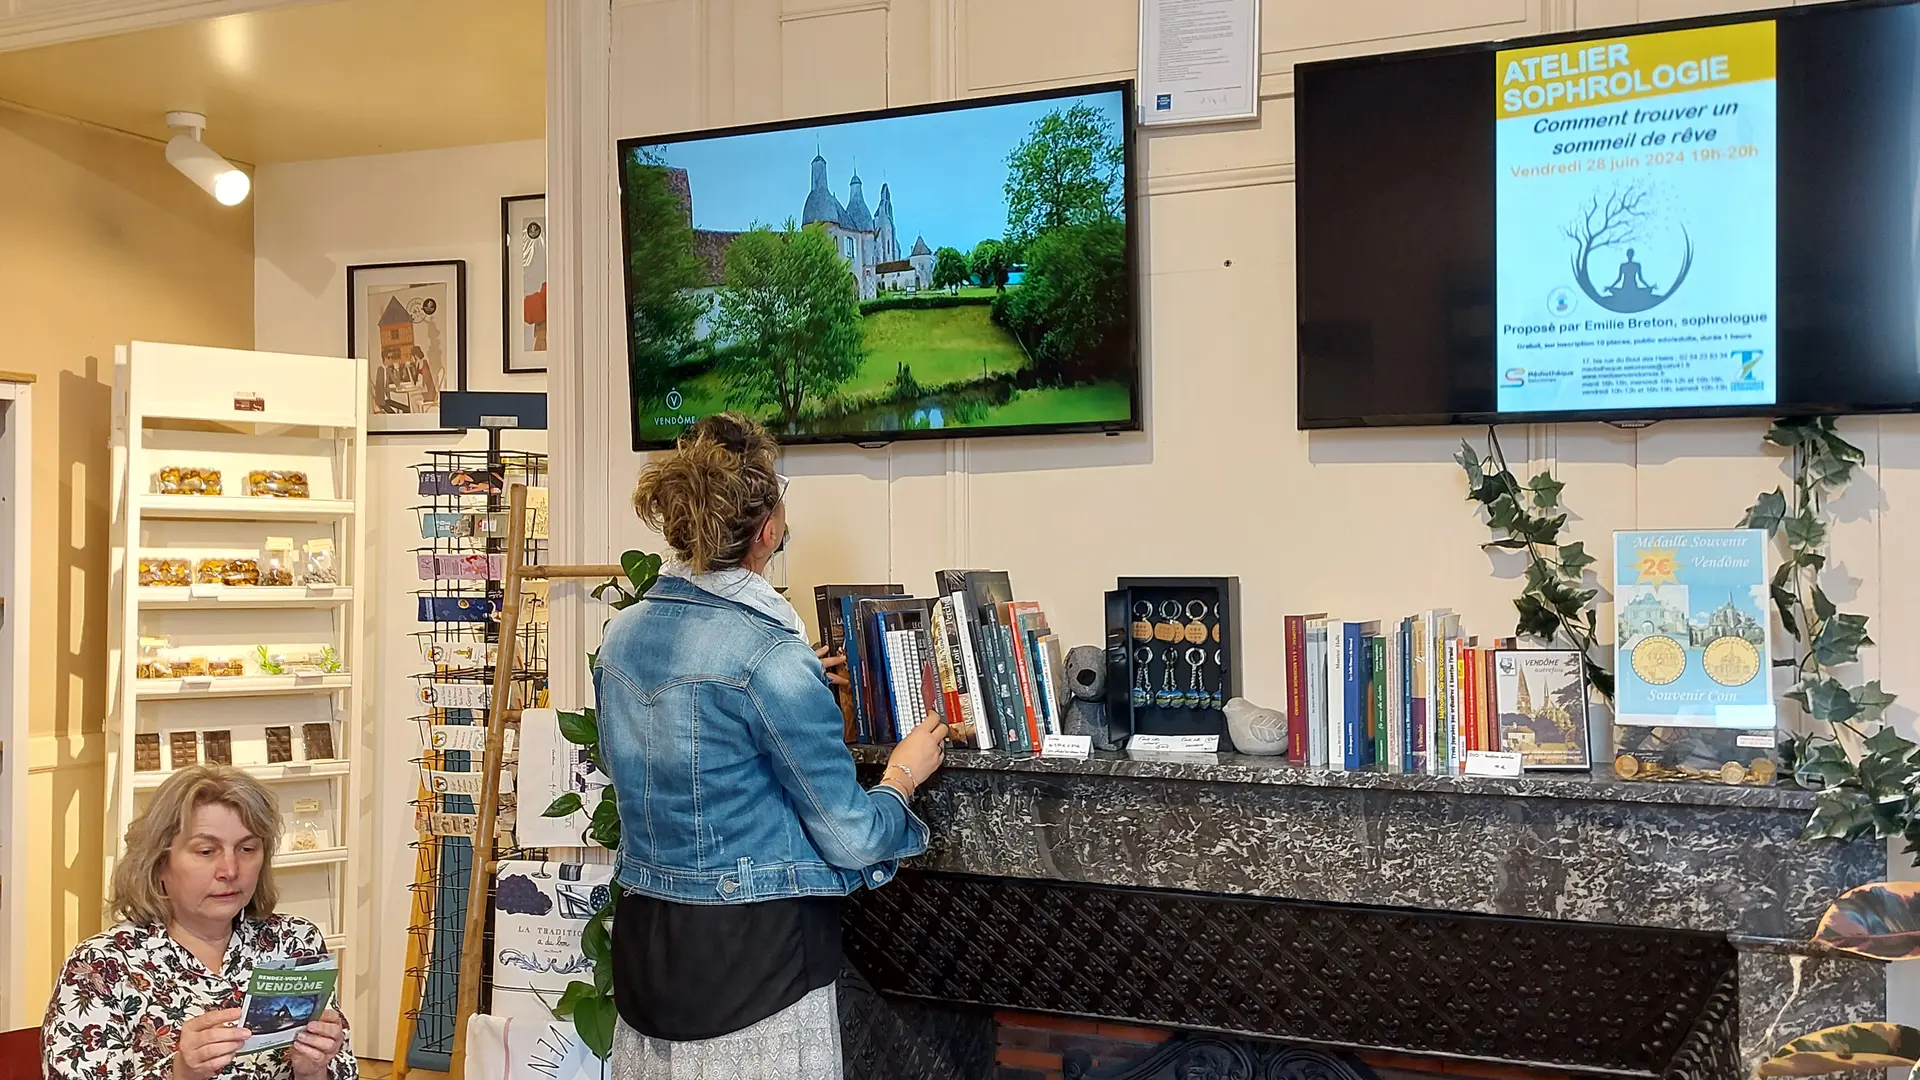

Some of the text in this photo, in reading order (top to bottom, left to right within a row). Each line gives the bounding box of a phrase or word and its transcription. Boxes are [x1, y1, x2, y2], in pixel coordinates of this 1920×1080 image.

[1503, 43, 1630, 86] ATELIER
[1503, 55, 1730, 113] SOPHROLOGIE
[1533, 101, 1738, 134] Comment trouver un
[1552, 127, 1717, 155] sommeil de rêve
[1510, 146, 1759, 178] Vendredi 28 juin 2024 19h-20h
[1503, 313, 1767, 336] Proposé par Emilie Breton, sophrologue
[654, 415, 697, 426] VENDÔME
[1632, 534, 1748, 549] Médaille Souvenir
[1641, 557, 1672, 576] 2€
[1691, 554, 1750, 569] Vendôme
[940, 597, 954, 625] Perche
[940, 654, 947, 663] du
[950, 647, 961, 666] Loir
[1525, 658, 1560, 667] VENDÔME
[940, 663, 951, 688] Histoire
[1534, 667, 1564, 675] autrefois
[1437, 681, 1444, 689] de
[1647, 688, 1738, 702] Souvenir Coin
[537, 927, 583, 938] TRADITIO
[545, 936, 555, 946] du
[555, 936, 570, 948] bon
[258, 974, 303, 982] RENDEZ-VOUS
[256, 981, 324, 991] VENDÔME
